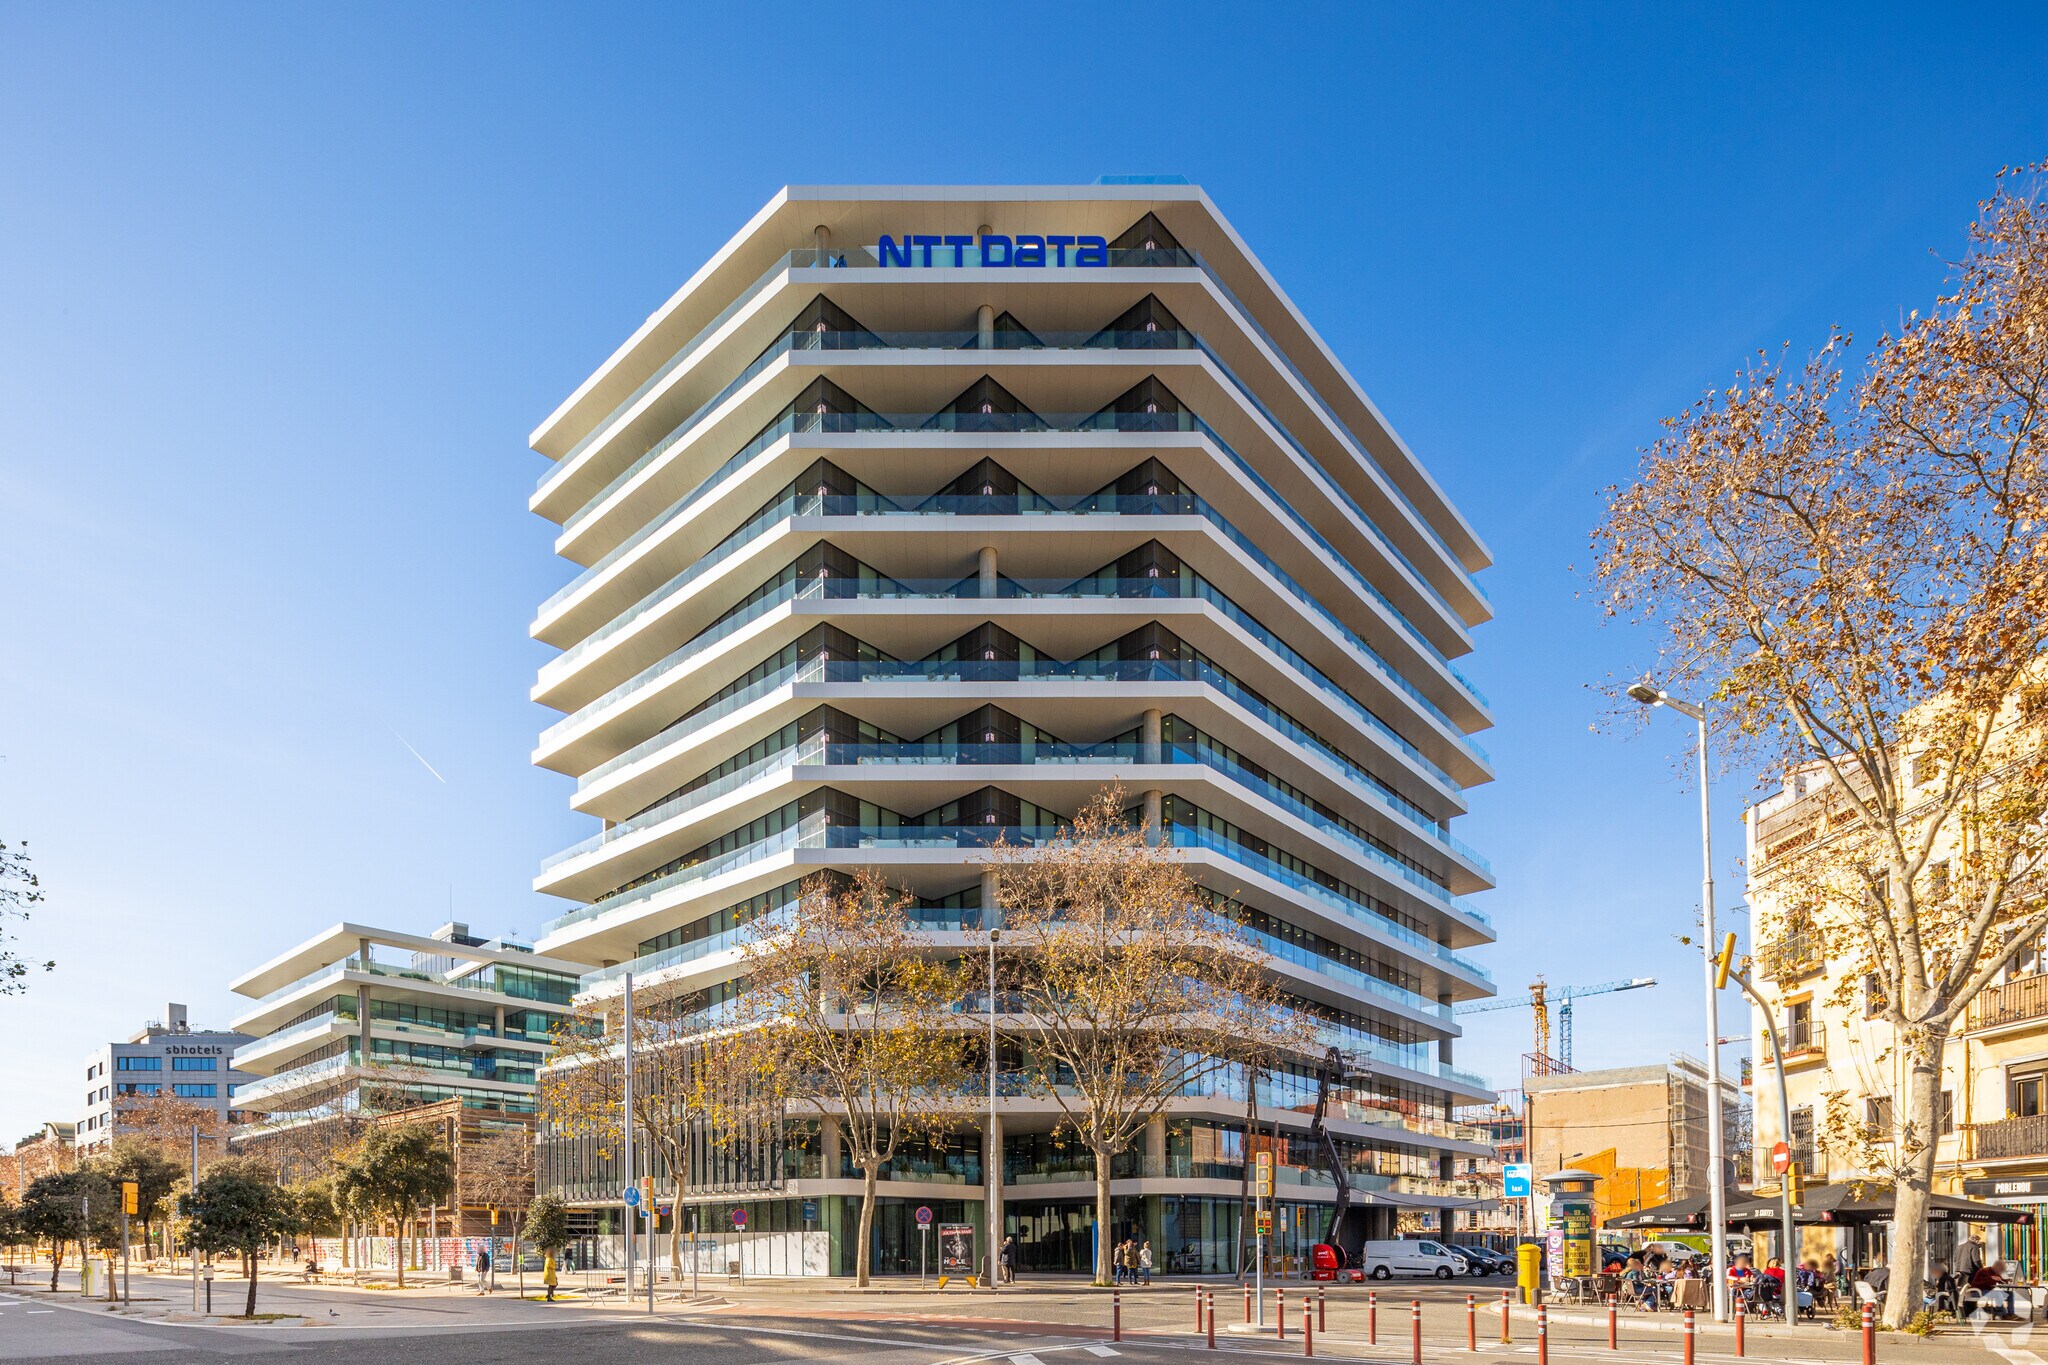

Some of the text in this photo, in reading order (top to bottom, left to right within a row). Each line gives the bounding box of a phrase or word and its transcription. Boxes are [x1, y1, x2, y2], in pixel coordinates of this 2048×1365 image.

[879, 234, 1108, 268] NTT DATA
[165, 1045, 223, 1055] sbhotels
[1995, 1182, 2031, 1194] POBLENOU
